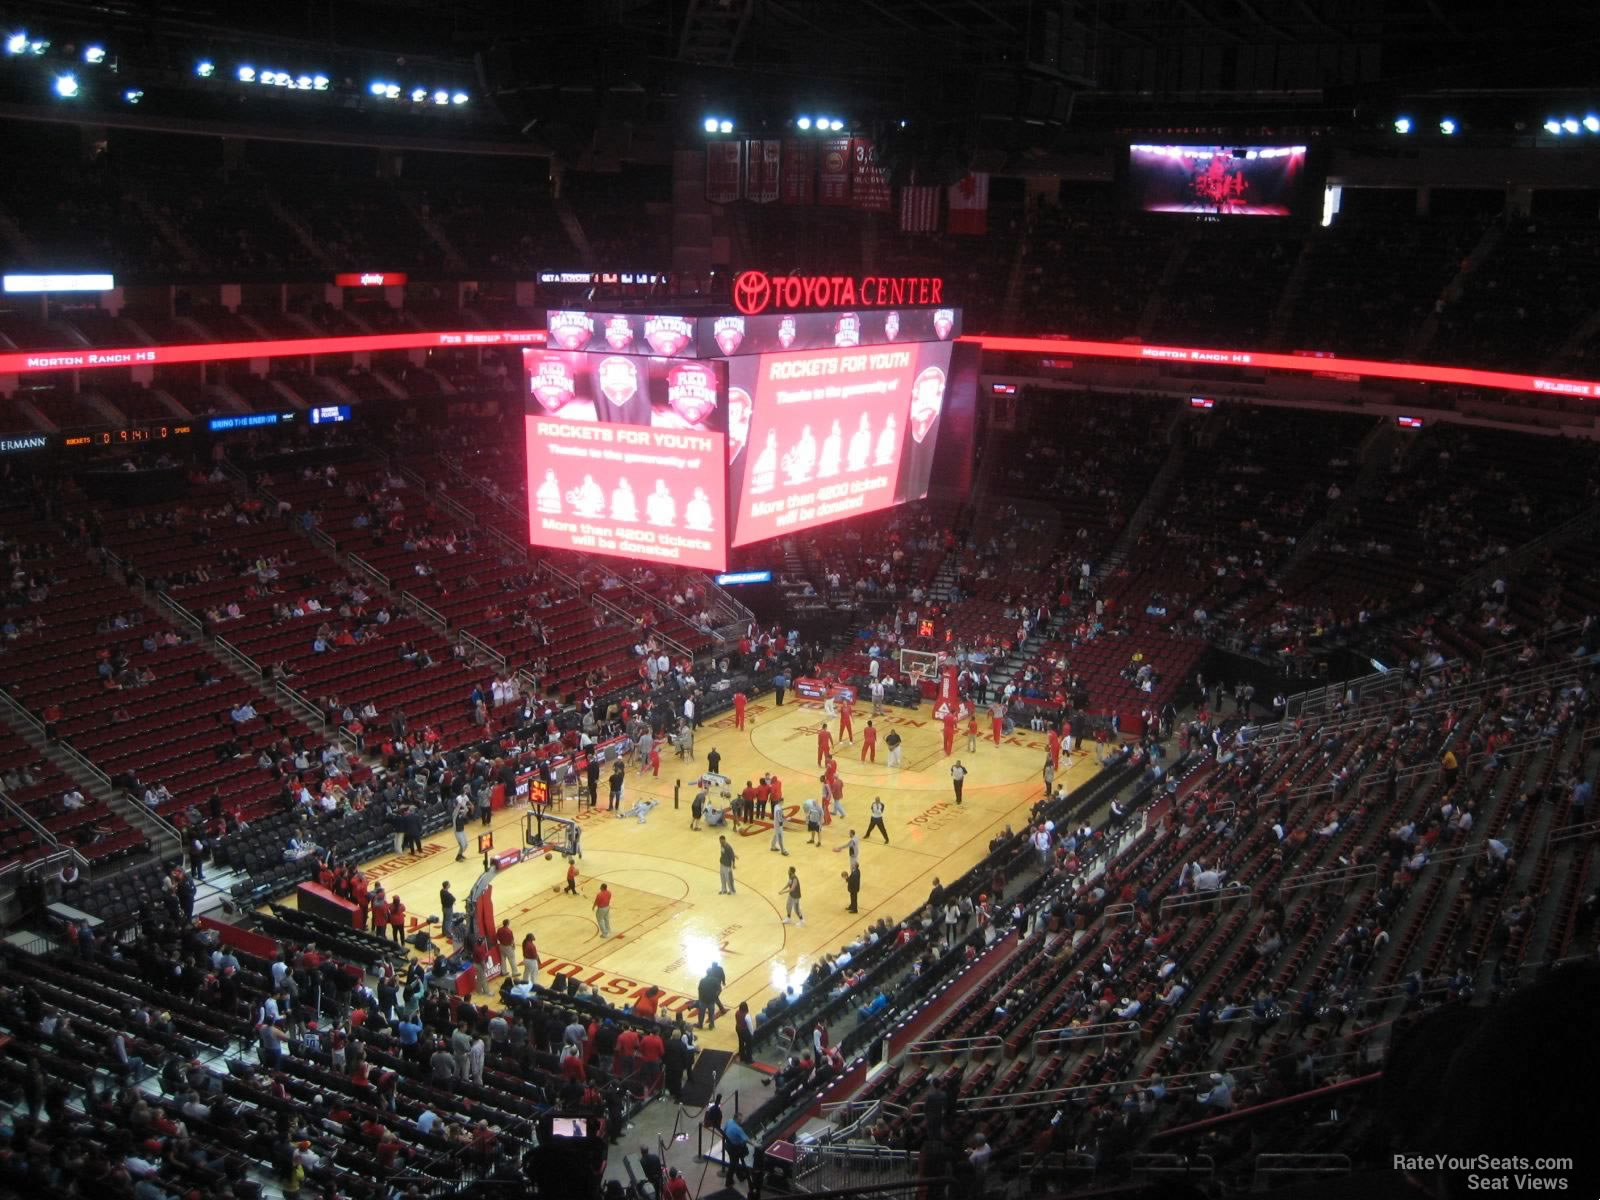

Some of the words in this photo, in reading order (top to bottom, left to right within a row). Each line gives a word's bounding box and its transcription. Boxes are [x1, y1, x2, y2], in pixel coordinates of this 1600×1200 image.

[773, 276, 856, 307] TOYOTA
[861, 277, 944, 305] CENTER
[28, 357, 83, 367] MORTON
[88, 354, 131, 364] RANCH
[1142, 348, 1186, 358] MORTON
[1191, 352, 1228, 361] RANCH
[769, 358, 838, 380] ROCKETS
[840, 355, 867, 373] FOR
[869, 352, 910, 369] YOUTH
[212, 420, 233, 429] BRING
[234, 418, 248, 427] THE
[1, 437, 47, 450] ERMANN
[104, 434, 109, 444] 0
[161, 428, 167, 438] 0
[537, 422, 613, 441] ROCKETS
[616, 429, 650, 446] FOR
[654, 433, 712, 452] YOUTH
[542, 518, 577, 533] More
[580, 524, 612, 537] than
[658, 533, 712, 550] tickets
[572, 536, 595, 547] will
[598, 537, 616, 549] be
[619, 540, 680, 558] donated
[906, 802, 953, 826] TOYOTA
